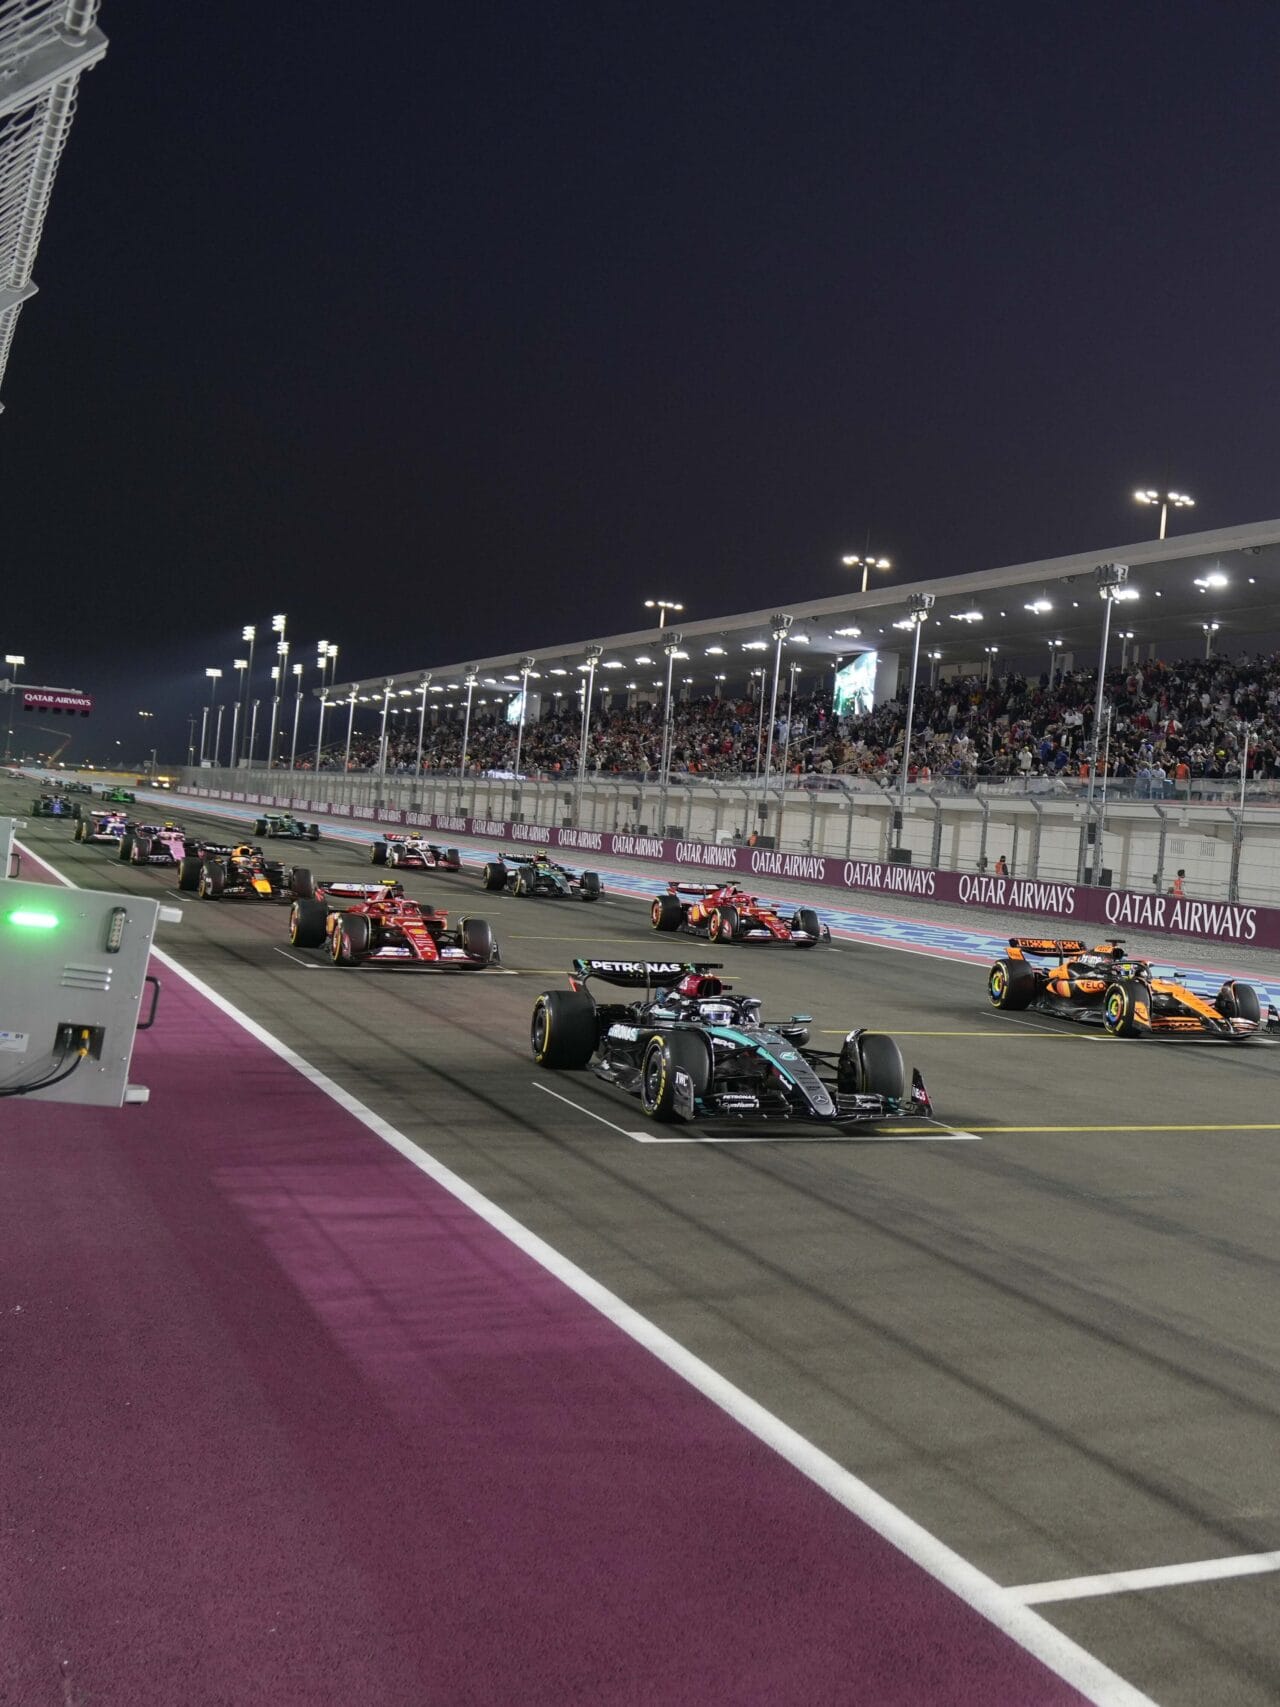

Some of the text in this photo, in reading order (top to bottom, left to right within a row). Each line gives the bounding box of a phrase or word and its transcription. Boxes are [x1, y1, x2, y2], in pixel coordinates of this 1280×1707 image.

[24, 693, 92, 706] QATAR AIRWAYS
[472, 819, 505, 837] QATAR AIRWAYS
[511, 823, 550, 843] QATAR AIRWAYS
[558, 828, 602, 850] QATAR AIRWAYS
[612, 835, 664, 858] QATAR AIRWAYS
[675, 842, 737, 868] QATAR AIRWAYS
[751, 850, 825, 880] QATAR AIRWAYS
[844, 862, 936, 895] QATAR AIRWAYS
[958, 875, 1075, 914] QATAR AIRWAYS
[1105, 892, 1257, 940] QATAR AIRWAYS
[591, 960, 681, 972] PETRONAS
